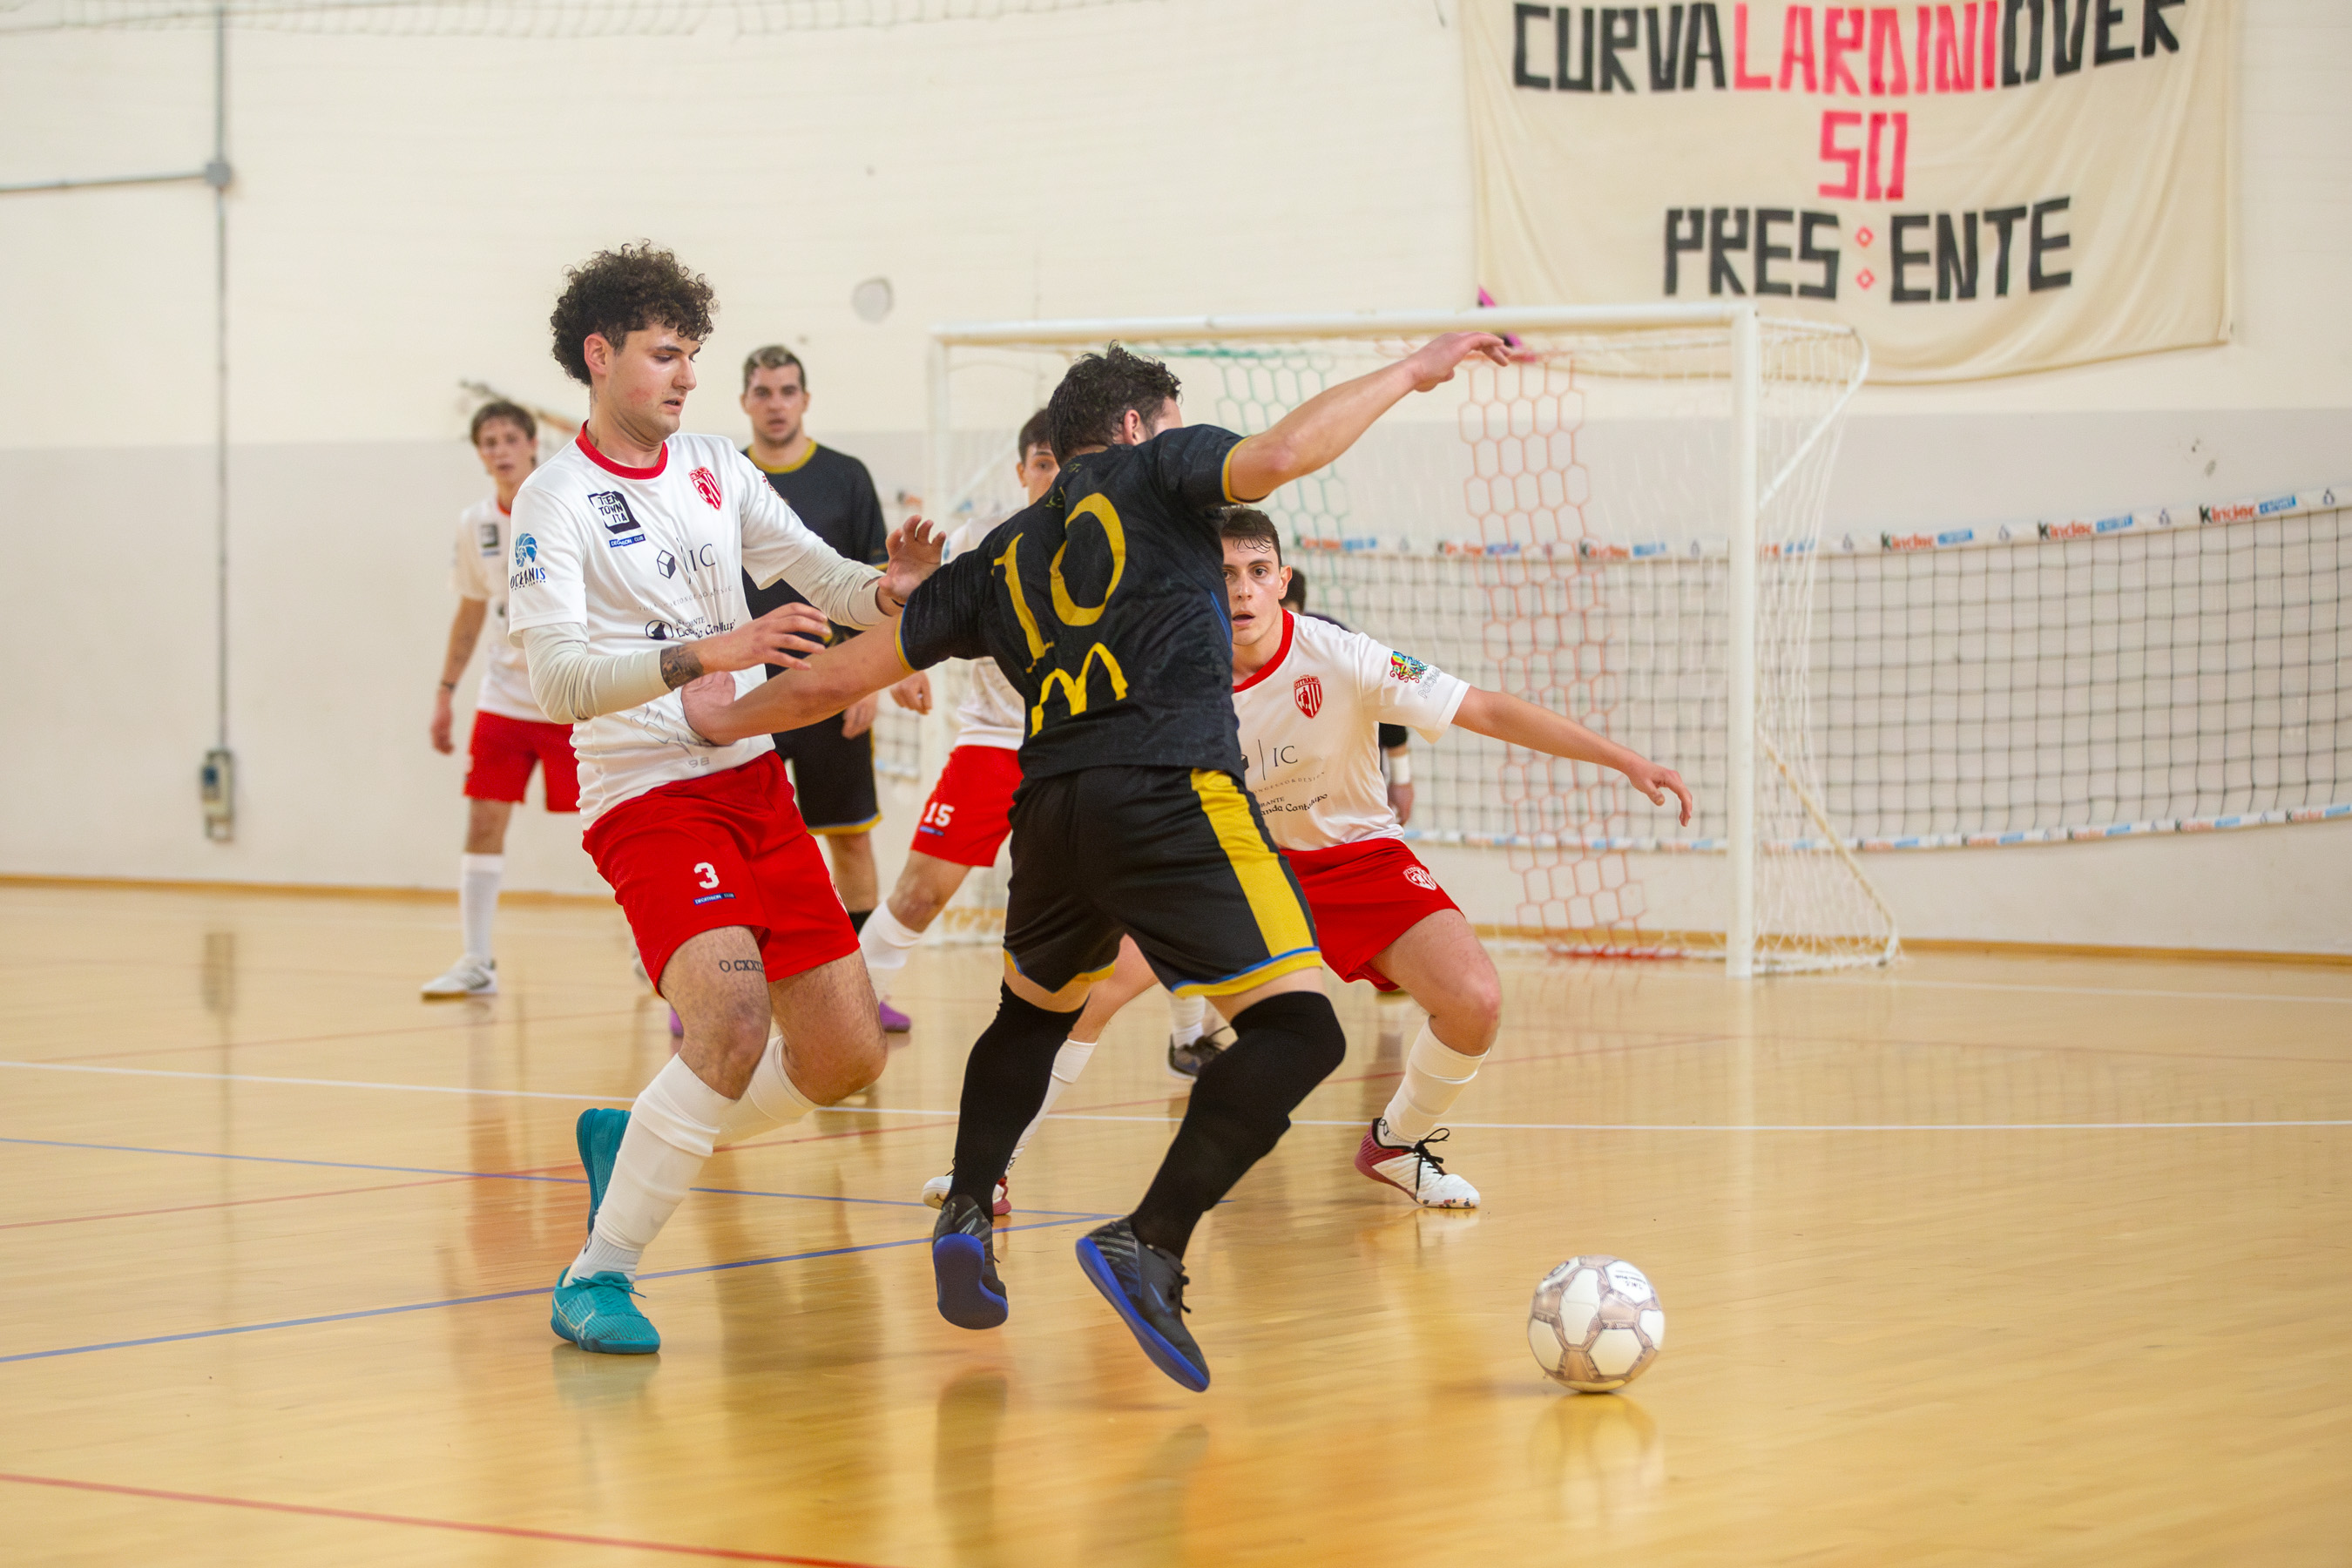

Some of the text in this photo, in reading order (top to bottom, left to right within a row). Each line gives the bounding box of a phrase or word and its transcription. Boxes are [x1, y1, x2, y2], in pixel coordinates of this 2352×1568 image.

[598, 503, 623, 517] TOWN
[612, 512, 628, 524] ITA
[510, 567, 546, 589] OCEANIS
[923, 801, 956, 828] 15
[693, 862, 720, 889] 3
